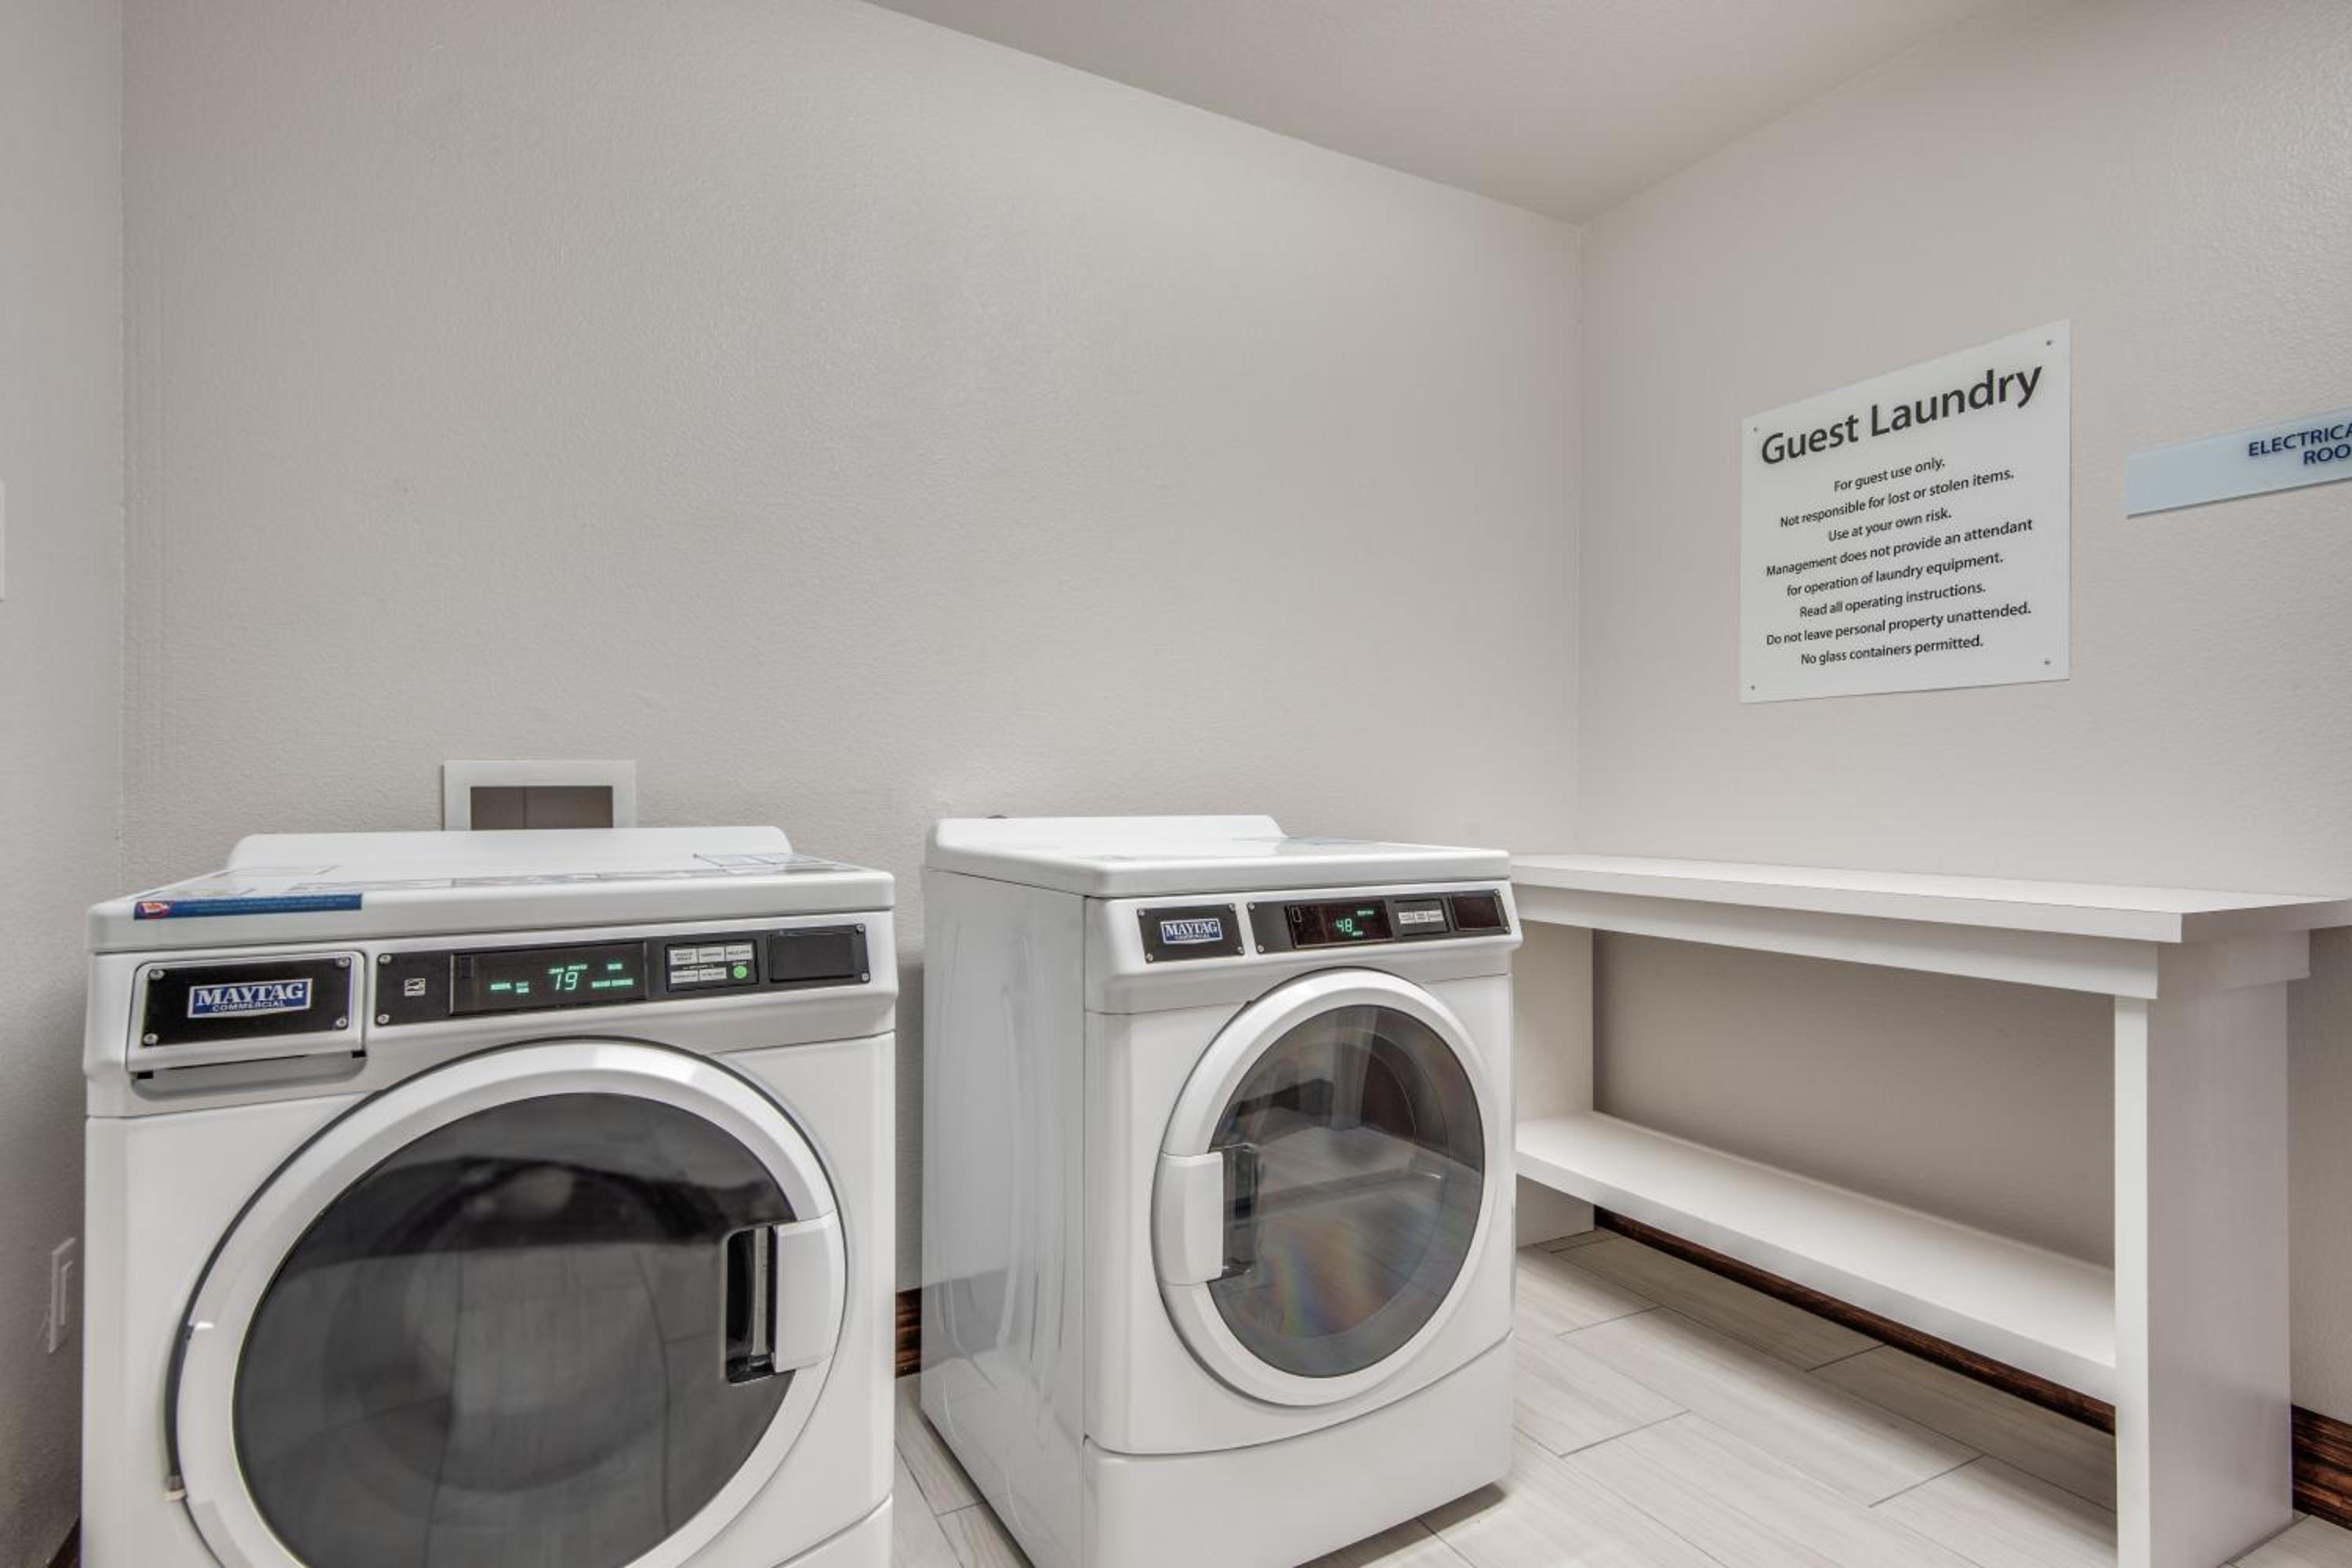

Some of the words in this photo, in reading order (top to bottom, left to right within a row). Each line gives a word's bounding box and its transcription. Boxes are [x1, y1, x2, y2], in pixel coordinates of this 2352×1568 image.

[1762, 414, 1859, 465] Guest
[1871, 365, 2042, 437] Laundry
[1834, 480, 1853, 492] For
[1854, 470, 1889, 490] guest
[1890, 466, 1912, 479] use
[1915, 457, 1945, 473] only.
[1973, 470, 2014, 486] items.
[1780, 515, 1800, 528] Not
[1802, 499, 1866, 523] responsible
[1868, 496, 1886, 509] for
[1888, 490, 1911, 505] lost
[1913, 487, 1927, 499] or
[1929, 479, 1969, 496] stolen
[1896, 516, 1922, 528] own
[1926, 507, 1952, 522] risk.
[1828, 529, 1849, 542] Use
[1851, 526, 1864, 537] at
[1865, 521, 1893, 537] your
[1964, 519, 2033, 542] attendant
[1893, 535, 1942, 557] provide
[1944, 534, 1961, 545] an
[1839, 550, 1867, 564] does
[1870, 546, 1891, 558] not
[1766, 555, 1838, 577] Management
[1926, 552, 2003, 575] equipment.
[1860, 571, 1874, 584] of
[1876, 565, 1923, 583] laundry
[1787, 584, 1802, 597] for
[1804, 576, 1859, 595] operation
[1906, 583, 1986, 603] instructions.
[1799, 603, 1828, 618] Read
[1829, 601, 1843, 614] all
[1845, 594, 1903, 613] operating
[1947, 601, 2031, 623] unattended.
[1835, 619, 1886, 640] personal
[1889, 615, 1944, 634] property
[1766, 634, 1782, 645] Do
[1784, 632, 1802, 644] not
[1804, 627, 1833, 641] leave
[1801, 654, 1817, 665] No
[1818, 650, 1847, 666] glass
[1849, 644, 1912, 660] containers
[1166, 921, 1218, 937] MAYTAG
[1336, 918, 1352, 932] 48
[196, 982, 303, 1006] MAYTAG
[212, 1000, 285, 1012] COMMERCIAL
